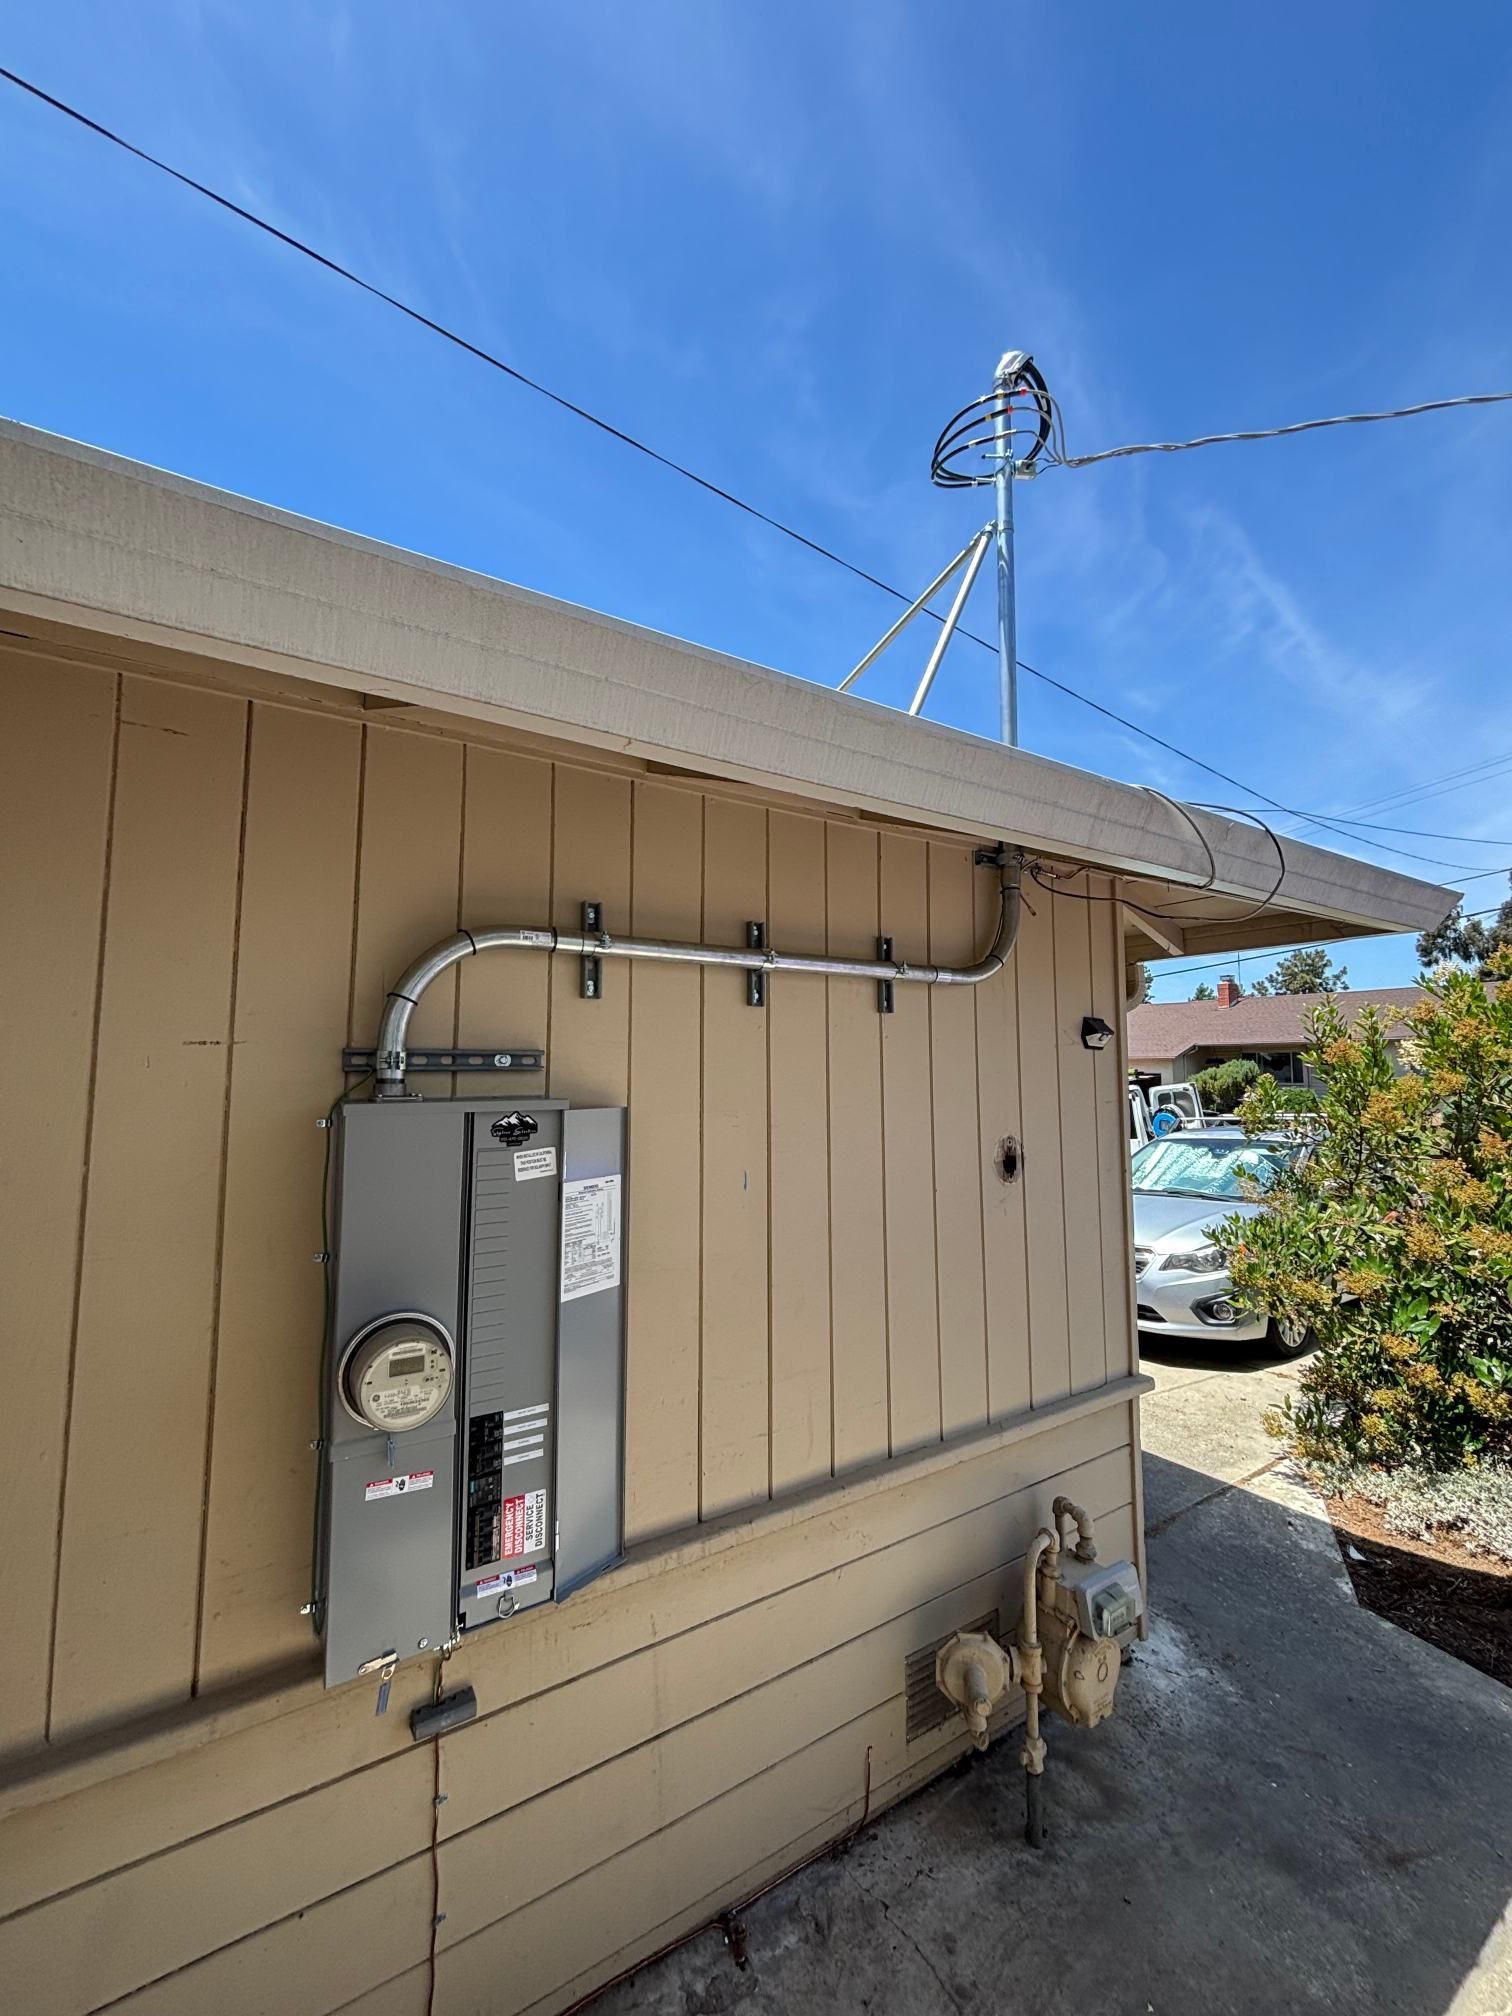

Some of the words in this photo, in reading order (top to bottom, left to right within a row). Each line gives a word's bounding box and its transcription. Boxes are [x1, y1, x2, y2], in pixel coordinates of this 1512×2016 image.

[504, 1503, 514, 1556] EMERGENCY
[514, 1498, 524, 1554] DISCONNECT
[526, 1503, 534, 1541] SERVICE
[534, 1493, 544, 1548] DISCONNECT
